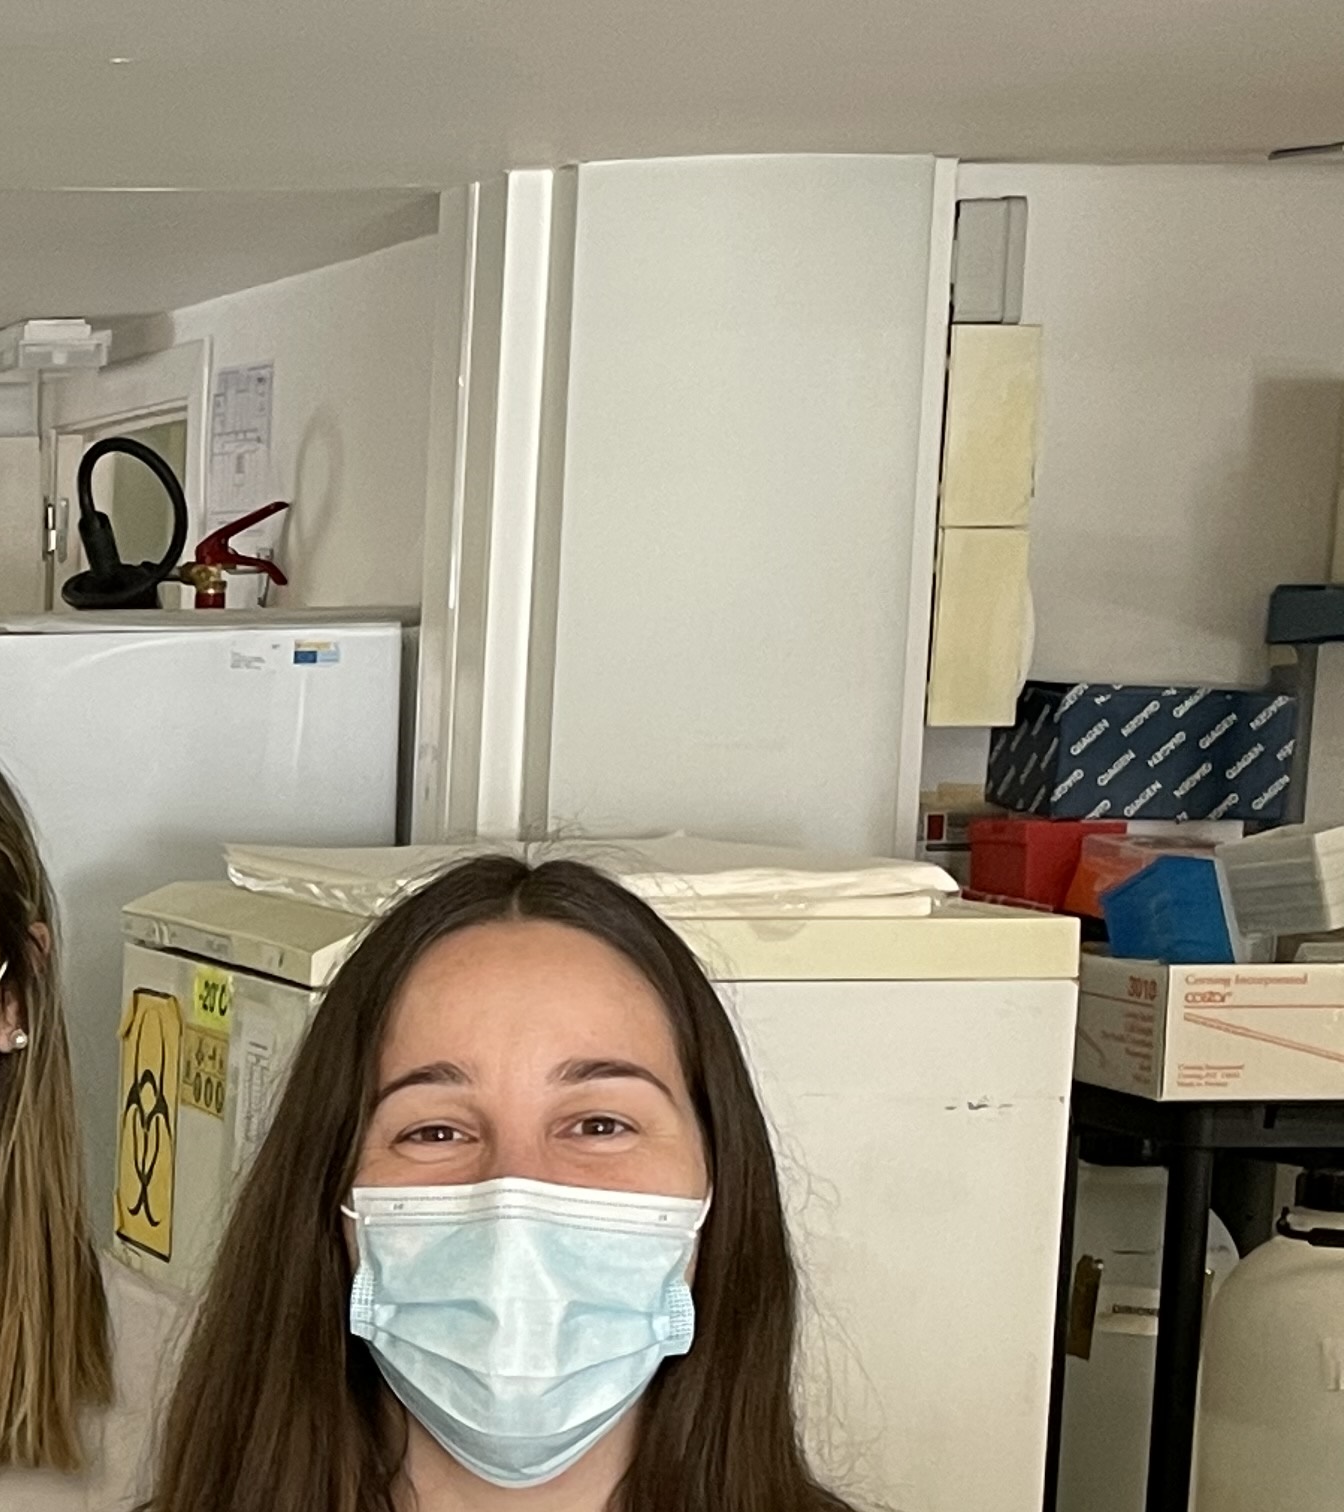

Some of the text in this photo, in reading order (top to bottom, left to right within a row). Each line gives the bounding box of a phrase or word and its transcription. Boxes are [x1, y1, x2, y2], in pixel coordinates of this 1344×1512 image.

[1070, 718, 1110, 755] QIAGEN
[1120, 700, 1160, 737] QIAGEN
[1199, 712, 1238, 749] QIAGEN
[1097, 749, 1136, 786] QIAGEN
[1147, 731, 1186, 768] QIAGEN
[1225, 742, 1265, 779] QIAGEN
[1123, 780, 1162, 817] QIAGEN
[1252, 774, 1290, 810] QIAGEN
